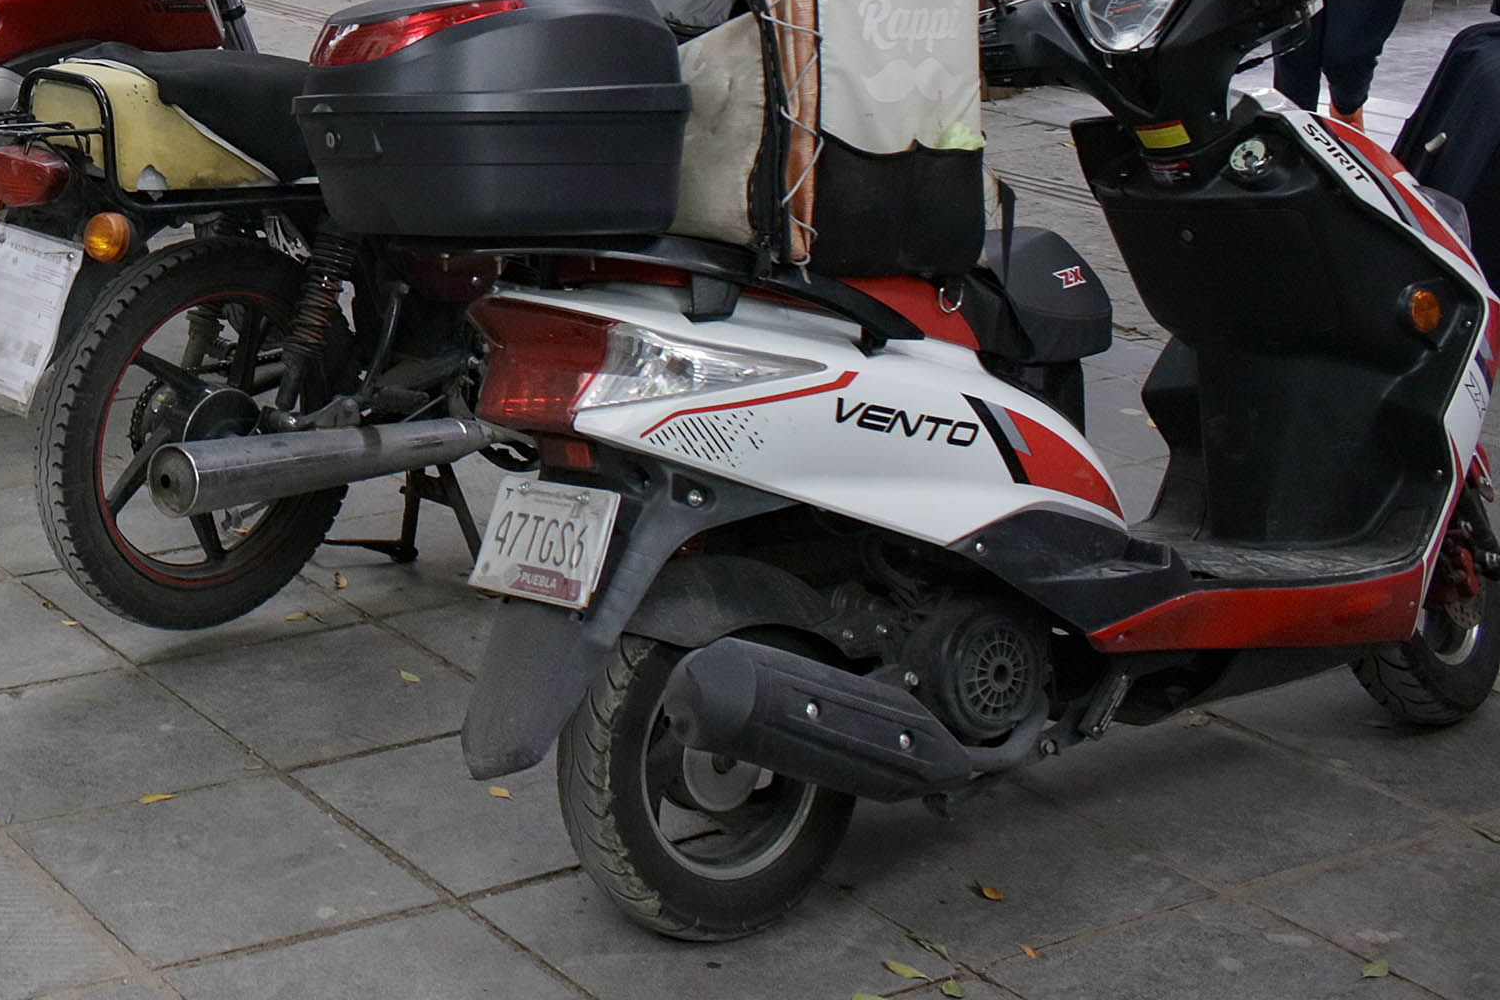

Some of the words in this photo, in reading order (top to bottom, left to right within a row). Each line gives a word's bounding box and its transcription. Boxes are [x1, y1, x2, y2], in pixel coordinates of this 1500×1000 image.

[1302, 123, 1369, 183] SPIRIT
[836, 397, 979, 447] VENTO
[521, 571, 557, 589] PUEBLA
